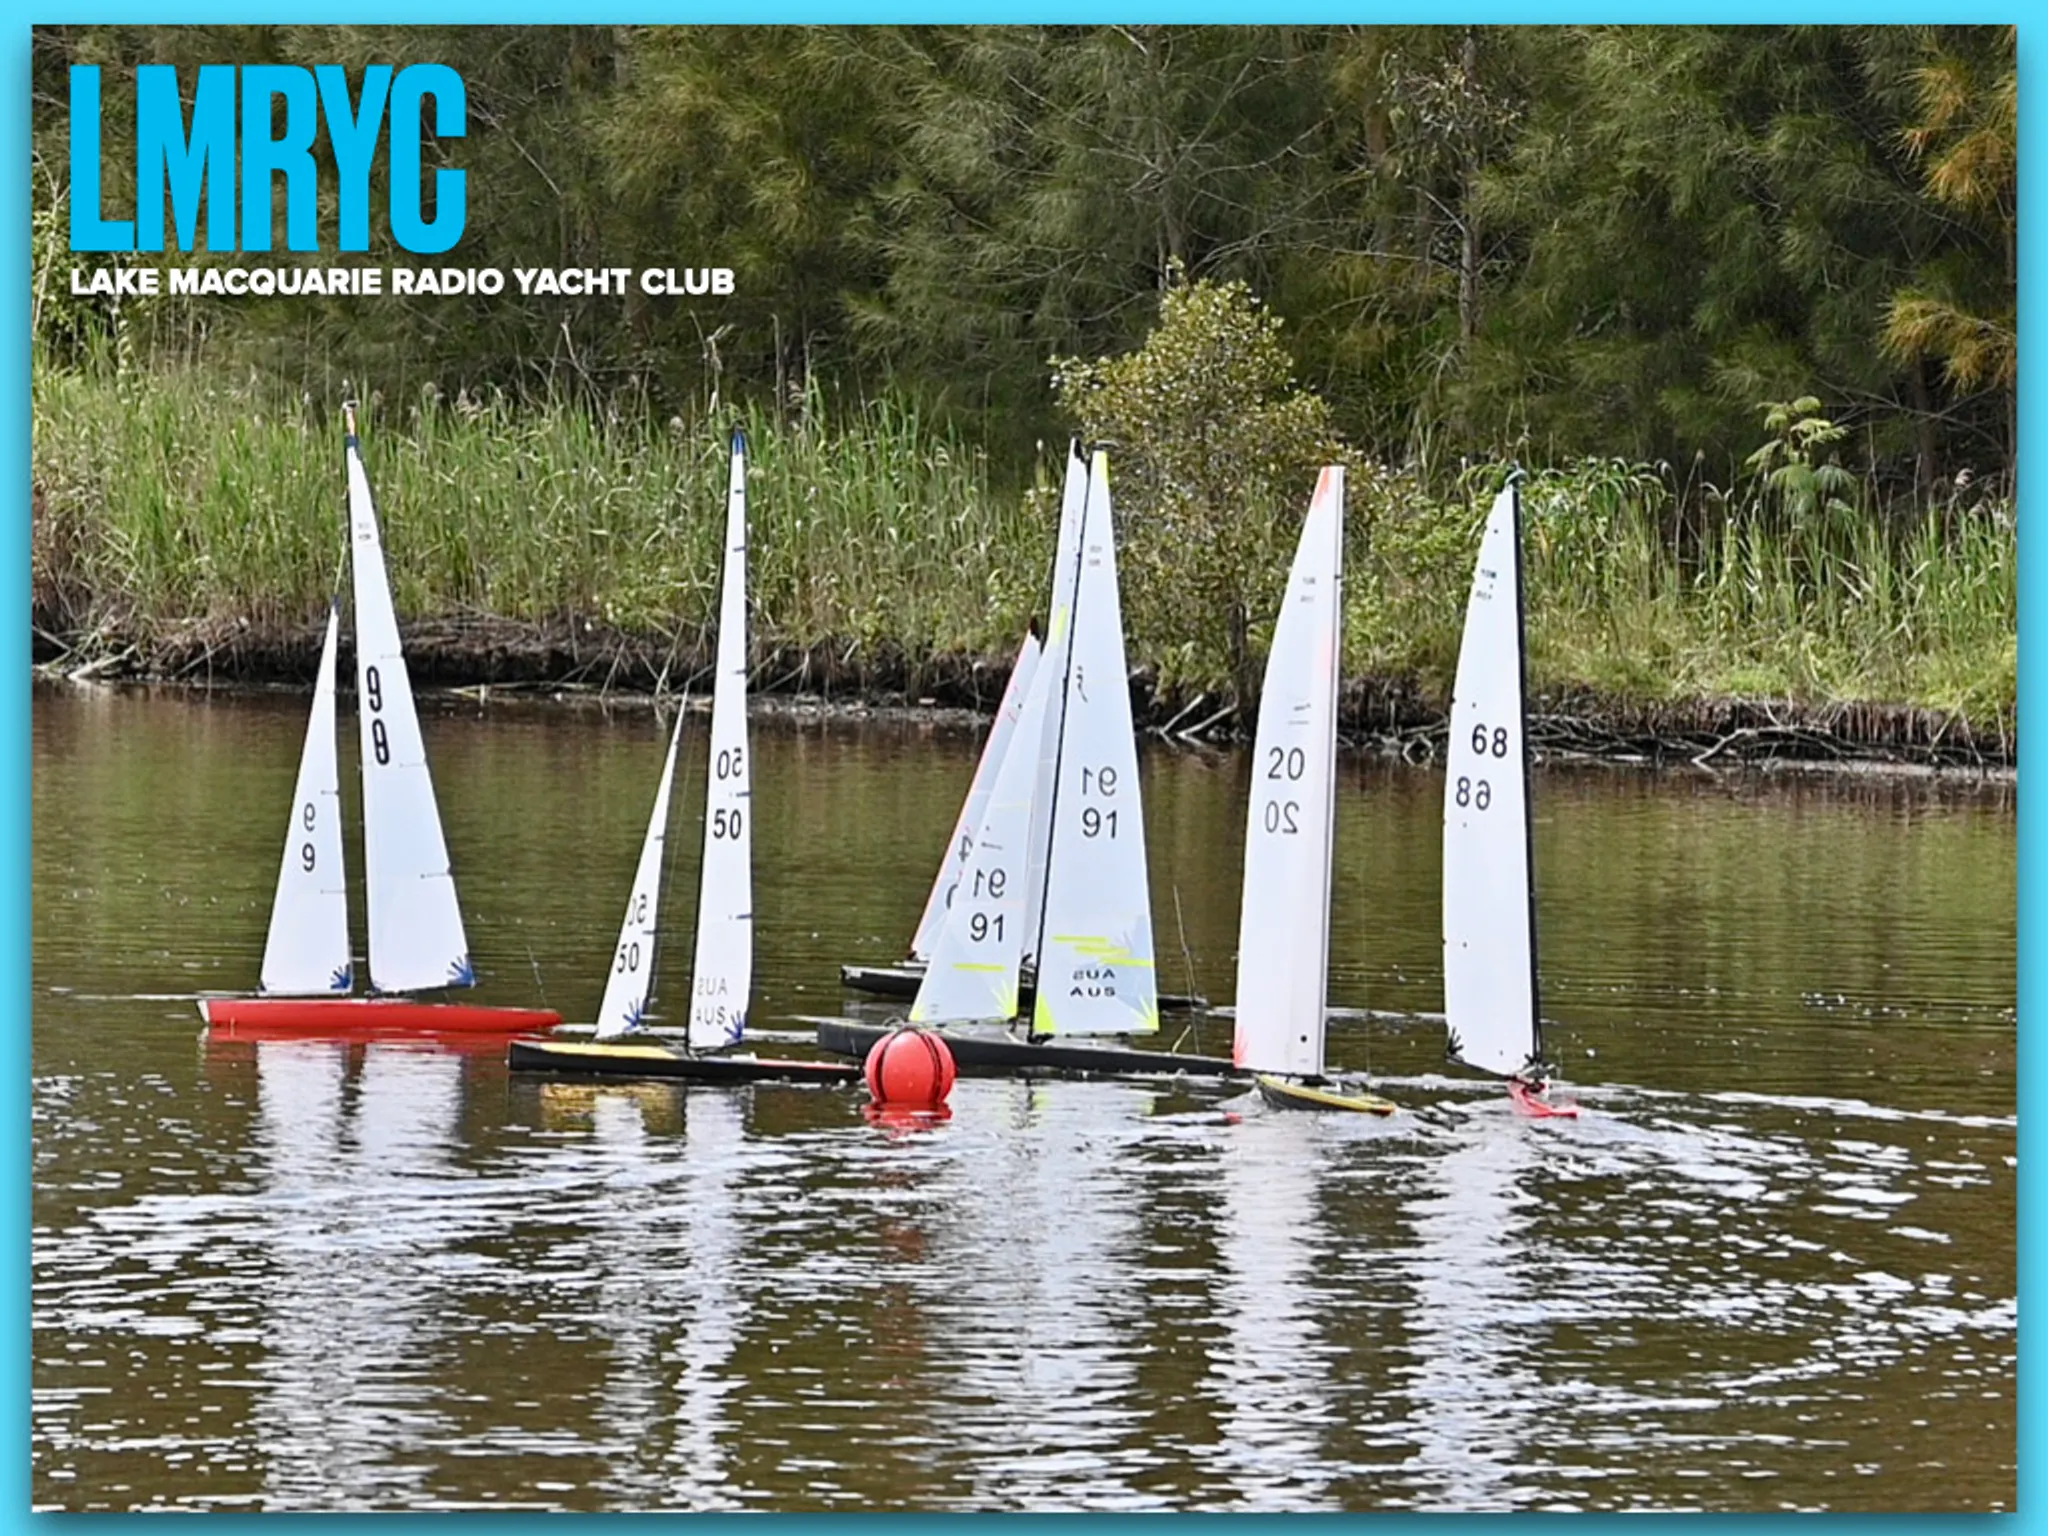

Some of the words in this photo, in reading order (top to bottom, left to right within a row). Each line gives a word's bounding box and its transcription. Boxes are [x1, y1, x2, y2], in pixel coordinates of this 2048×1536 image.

[366, 665, 383, 713] 9
[1471, 723, 1508, 759] 68
[1267, 746, 1305, 782] 20
[713, 808, 742, 841] 50
[1082, 807, 1118, 840] 91
[302, 842, 316, 873] 9
[970, 912, 1004, 943] 91
[1069, 986, 1116, 998] AUS
